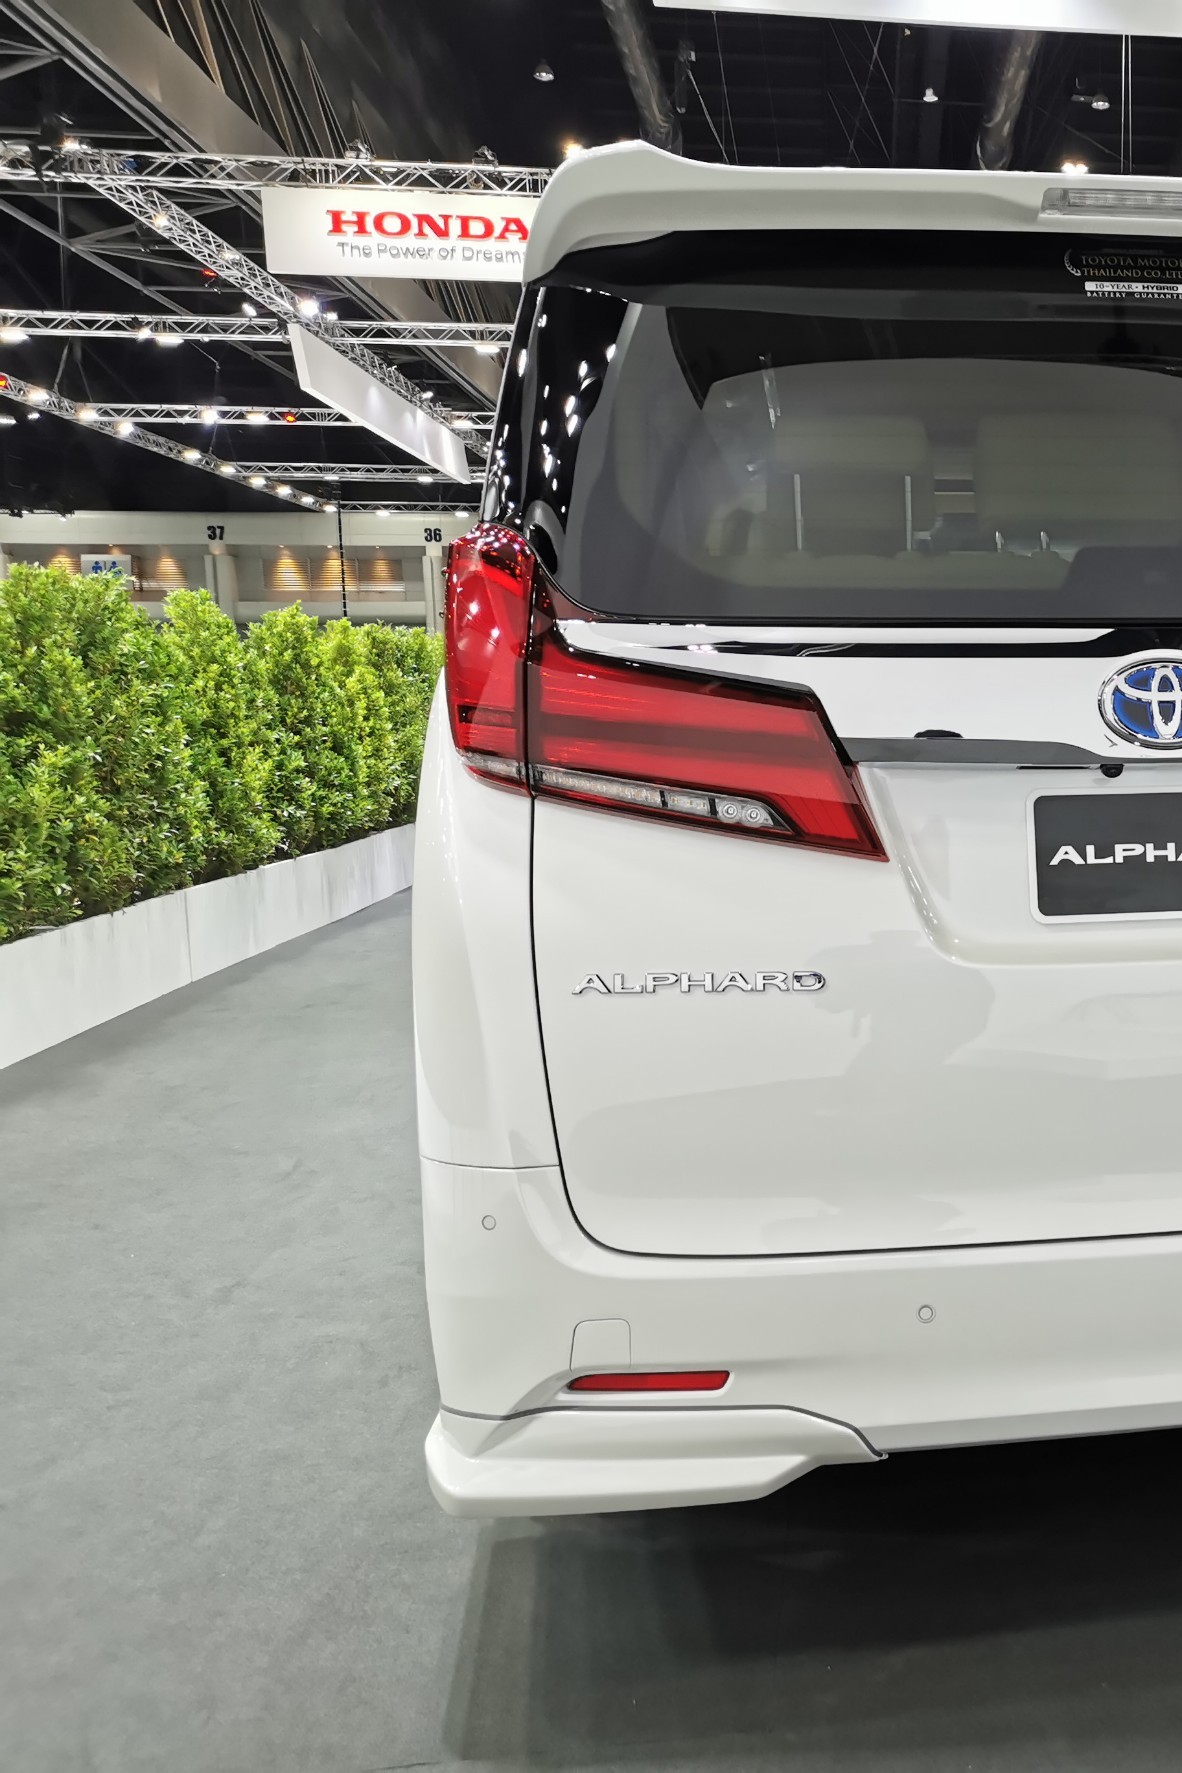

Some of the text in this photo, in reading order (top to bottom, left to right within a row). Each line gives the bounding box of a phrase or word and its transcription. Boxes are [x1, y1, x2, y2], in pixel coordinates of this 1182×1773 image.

[326, 209, 530, 243] HONDA
[336, 241, 373, 259] The
[377, 242, 434, 260] Power
[438, 245, 457, 260] of
[1081, 255, 1134, 267] TOYOTA
[1082, 267, 1142, 278] THAILAND
[1086, 291, 1127, 299] BATTERY
[1142, 284, 1179, 292] HYBRID
[206, 525, 225, 541] 37
[423, 527, 443, 543] 36
[571, 970, 827, 995] ALPHARD
